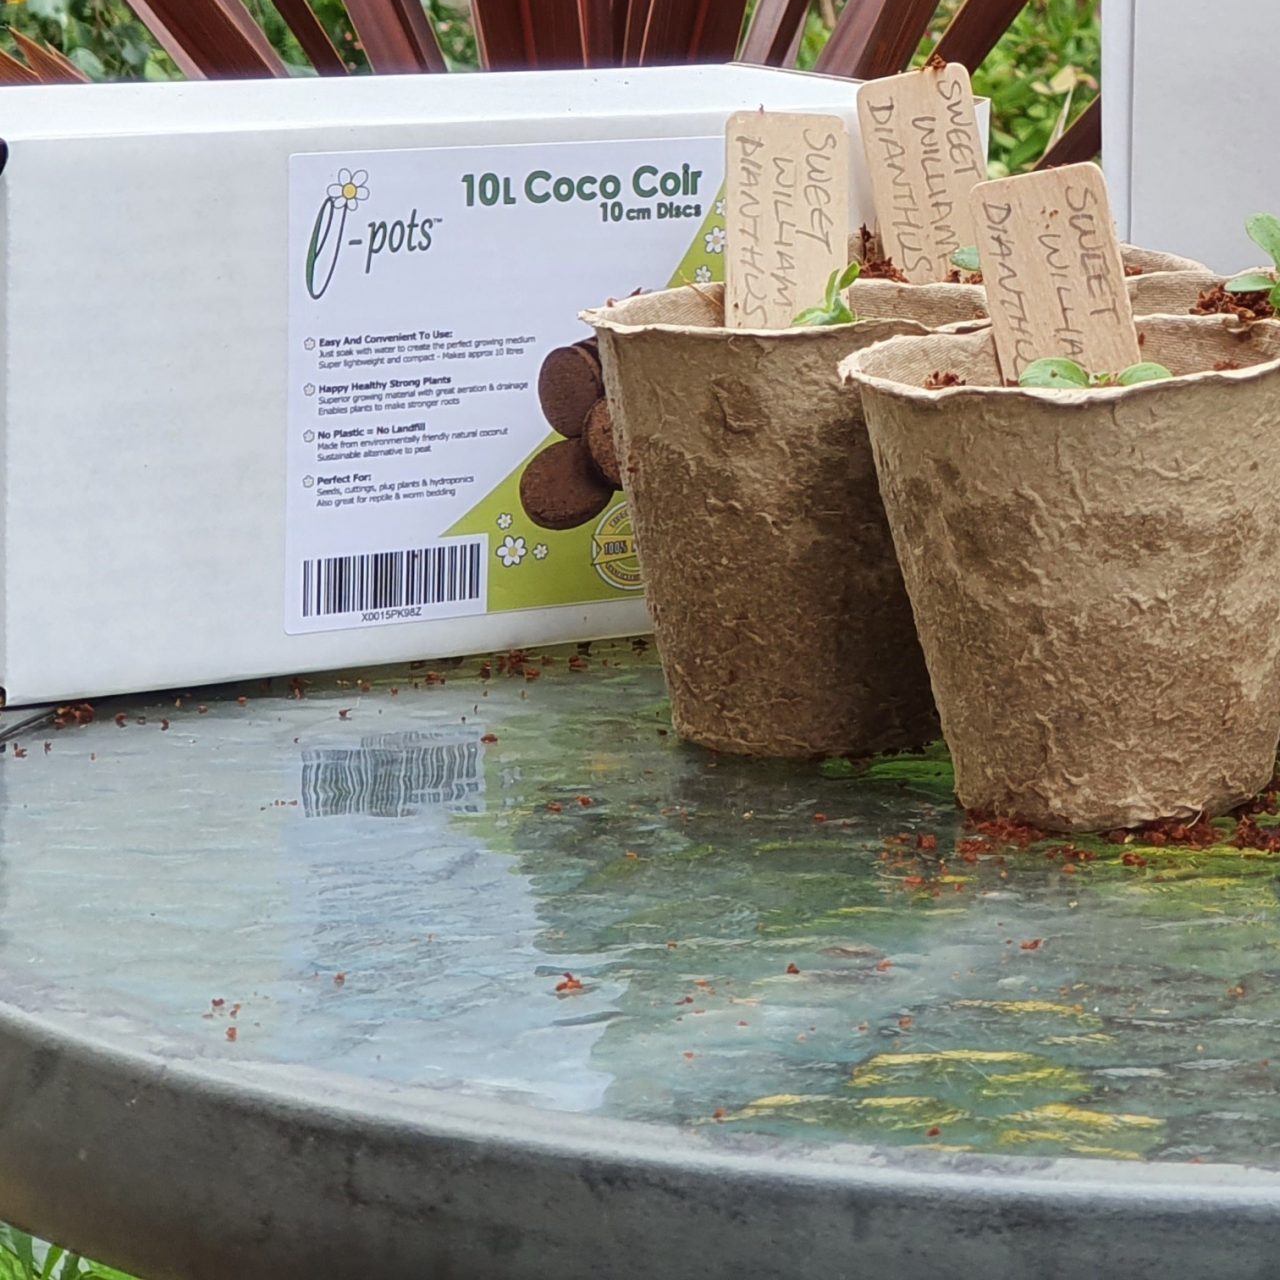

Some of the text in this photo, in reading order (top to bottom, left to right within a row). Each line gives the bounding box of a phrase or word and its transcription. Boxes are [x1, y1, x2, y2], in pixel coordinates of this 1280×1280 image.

[937, 79, 982, 179] SWEET
[461, 162, 703, 207] 10L Coco Coir
[656, 201, 702, 219] Discs
[736, 135, 767, 324] DIANTHUS
[770, 156, 797, 308] WILLIAM
[796, 128, 837, 255] SWEET
[867, 96, 933, 272] DIANTHUS
[1038, 233, 1086, 368] WILLIA
[1065, 186, 1120, 324] SWEET
[318, 337, 341, 348] Easy
[342, 335, 362, 346] And
[364, 332, 417, 344] Convenient
[418, 330, 431, 340] To
[318, 376, 452, 395] Happy Healthy Strong Plants
[316, 474, 351, 486] Perfect
[317, 430, 331, 440] No
[333, 427, 364, 438] Plastic
[376, 426, 390, 435] No
[391, 422, 426, 434] Landfill
